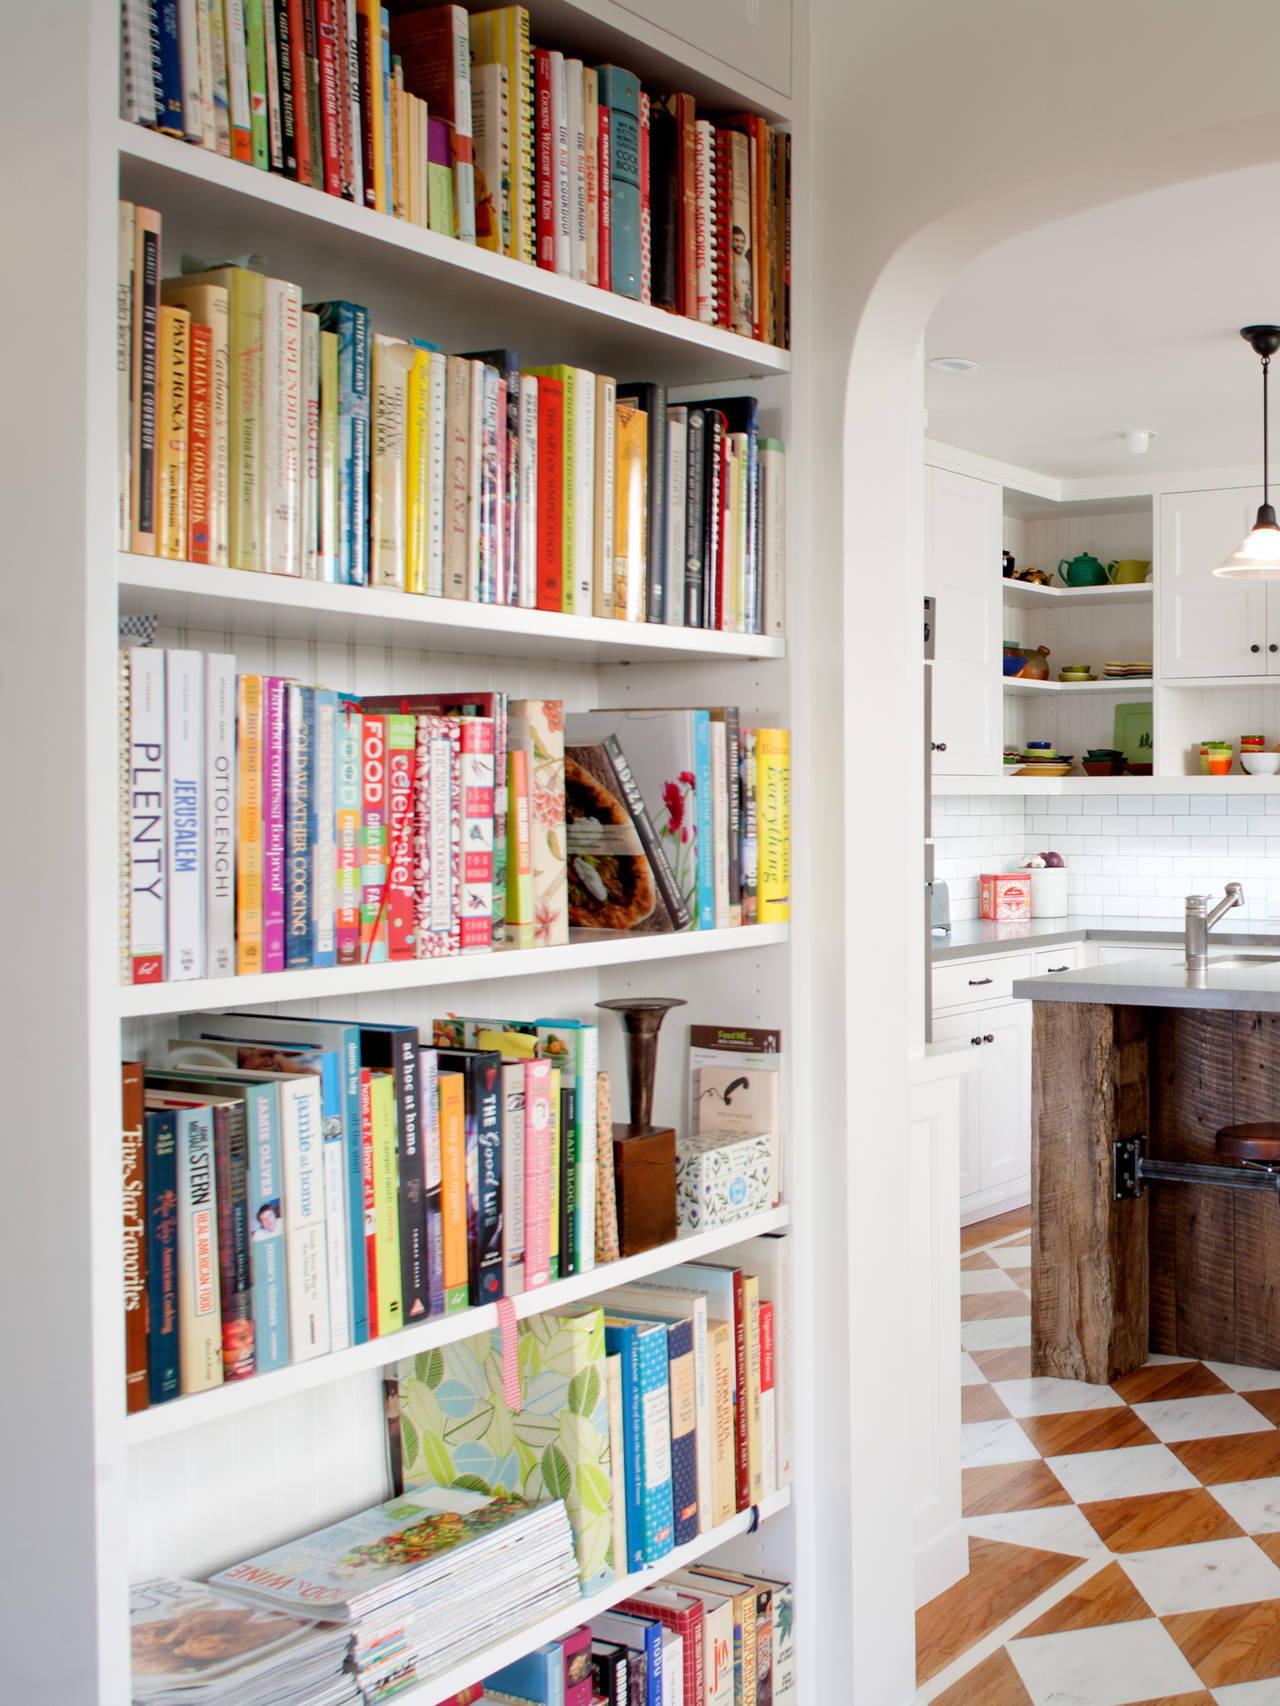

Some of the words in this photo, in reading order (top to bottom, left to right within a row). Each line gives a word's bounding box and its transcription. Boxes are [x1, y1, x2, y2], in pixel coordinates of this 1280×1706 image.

[279, 12, 288, 39] Gifts
[281, 43, 290, 68] from
[324, 44, 332, 59] THE
[349, 39, 360, 78] Olive
[282, 71, 291, 90] the
[324, 61, 336, 115] SRIRACHA
[351, 81, 360, 104] Oil
[283, 92, 294, 137] Kitchen
[541, 90, 552, 130] COOKING
[329, 117, 338, 158] COOKBOOK
[559, 126, 567, 144] the
[577, 132, 585, 150] the
[542, 133, 552, 177] WIZARDRY
[695, 131, 705, 200] MOUNTAIN
[542, 181, 551, 197] FOR
[602, 168, 610, 195] KIDS'
[542, 199, 553, 220] KIDS
[560, 181, 570, 237] cookbook
[577, 186, 586, 242] cookbook
[602, 196, 610, 227] FOOD!
[696, 205, 707, 269] MEMORIES
[143, 305, 155, 325] THE
[287, 298, 298, 333] THE
[143, 331, 155, 351] TRA
[172, 318, 185, 366] PASTA
[355, 311, 364, 362] PATIENCE
[142, 353, 154, 385] VIGNE
[192, 339, 207, 393] ITALIAN
[287, 336, 298, 428] SPLENDID
[354, 364, 364, 393] GRAY
[172, 371, 185, 432] FRESCA
[376, 384, 386, 419] COOK
[566, 382, 574, 395] IN
[142, 392, 154, 449] COOKBOOK
[193, 401, 206, 438] SOUP
[244, 417, 255, 452] Viana
[386, 395, 395, 449] ITALIAN
[454, 427, 465, 444] A
[546, 407, 556, 438] THE
[308, 399, 318, 479] RISOTTO
[376, 421, 387, 457] BOOK
[546, 440, 556, 462] ART
[244, 454, 254, 470] La
[546, 464, 555, 476] OF
[192, 442, 205, 524] COOKBOOK
[244, 471, 254, 506] Place
[453, 455, 465, 536] CASA
[546, 478, 556, 522] SIMPLE
[566, 458, 574, 508] KITCHEN
[545, 524, 555, 563] FOOD
[247, 684, 260, 707] the
[270, 687, 283, 752] barefoot
[247, 712, 259, 774] barefoot
[341, 737, 353, 786] everyday
[364, 721, 382, 802] FOOD
[436, 747, 445, 766] THE
[270, 755, 282, 819] contessa
[436, 769, 445, 798] NEW
[132, 742, 162, 901] PLENTY
[173, 779, 197, 872] JERUSALEM
[247, 778, 257, 844] contessa
[391, 755, 414, 891] celebrate!
[436, 801, 445, 835] BASICS
[518, 797, 528, 843] HEIRLOOM
[731, 784, 739, 831] BAKERY
[746, 800, 756, 846] STREET
[762, 766, 782, 884] Everything
[214, 756, 229, 898] OTTOLENGHI
[343, 815, 354, 850] FRESH
[367, 813, 381, 849] GREAT
[266, 823, 283, 894] foolproof
[343, 852, 354, 894] FLAVOR
[367, 853, 381, 885] FOOD
[437, 838, 446, 900] COOKBOOK
[747, 852, 757, 887] FOOD
[247, 846, 256, 919] cookbook
[291, 857, 307, 936] COOKING
[343, 896, 353, 922] FAST
[367, 887, 381, 916] FAST
[465, 921, 489, 931] COOK
[465, 932, 489, 943] BOOK
[348, 1043, 358, 1074] donna
[402, 1042, 413, 1061] ad
[347, 1077, 359, 1095] hay
[403, 1064, 415, 1091] hoc
[257, 1096, 270, 1141] JAMIE
[352, 1113, 361, 1128] off
[404, 1095, 415, 1110] at
[482, 1094, 496, 1127] THE
[187, 1120, 201, 1154] MICHAEL
[199, 1125, 209, 1144] JANE
[293, 1092, 315, 1153] jamie
[352, 1130, 361, 1147] the
[405, 1116, 417, 1156] home
[449, 1116, 460, 1140] easy
[512, 1114, 524, 1157] GOOD
[123, 1124, 144, 1220] Five-Star
[258, 1144, 272, 1197] OLIVER
[299, 1155, 309, 1169] at
[352, 1149, 362, 1174] shelf
[449, 1142, 460, 1178] green
[478, 1131, 502, 1186] Good
[190, 1152, 211, 1207] STERN
[300, 1170, 314, 1217] home
[450, 1180, 463, 1224] organic
[484, 1191, 497, 1228] LIFE
[513, 1195, 524, 1243] GRAIN
[193, 1212, 209, 1237] REAL
[433, 1213, 442, 1235] Ross
[123, 1222, 144, 1311] Favorites
[195, 1238, 211, 1286] AMERICAN
[264, 1242, 277, 1283] jamie's
[434, 1236, 443, 1275] Dobson
[199, 1288, 212, 1315] FOOD
[268, 1284, 280, 1326] dinners
[737, 1322, 745, 1342] THE
[764, 1311, 772, 1351] Vegetable
[721, 1367, 729, 1404] FROM
[764, 1353, 772, 1382] Harvest
[739, 1386, 747, 1437] VINEYARD
[716, 1398, 724, 1463] KITCHEN
[740, 1440, 749, 1470] TABLE
[223, 1563, 296, 1591] WINE
[743, 1600, 754, 1623] THE
[653, 1636, 662, 1678] nobu
[695, 1641, 703, 1669] SILVER
[708, 1636, 731, 1694] joy
[743, 1624, 754, 1685] CALIFORNIA
[695, 1671, 704, 1701] PALATE
